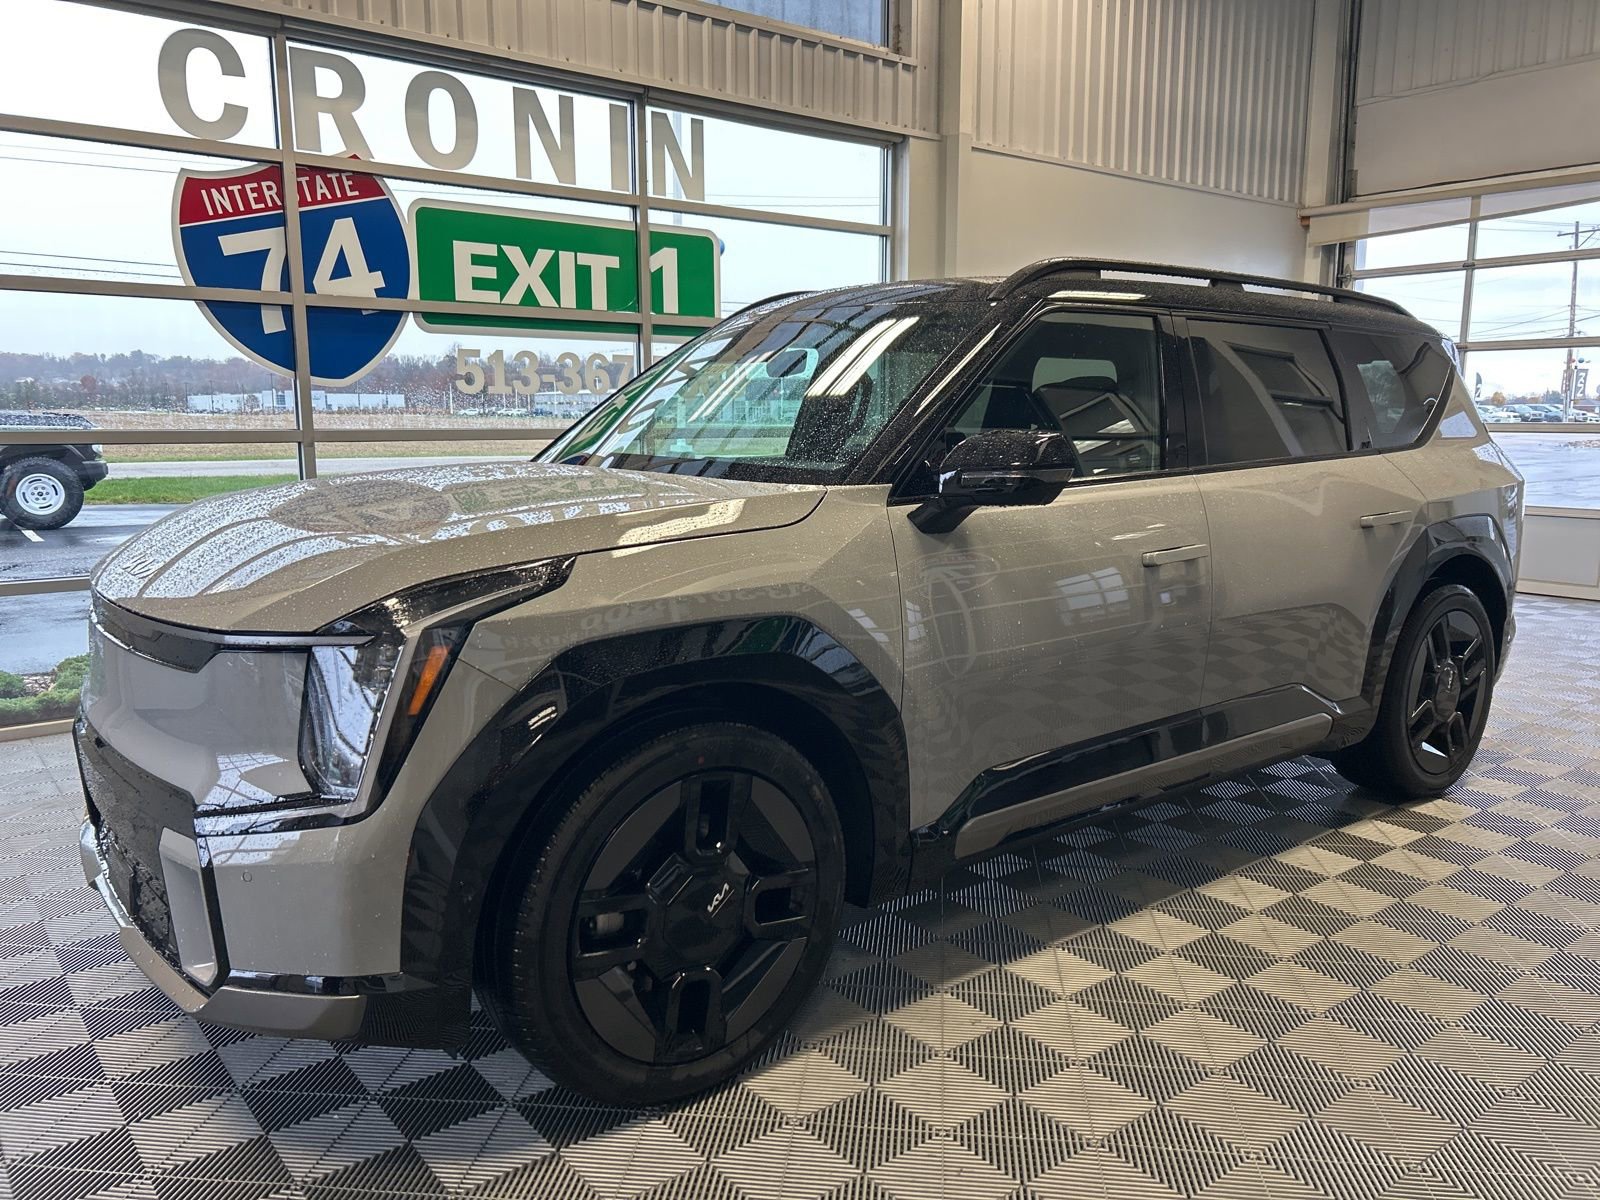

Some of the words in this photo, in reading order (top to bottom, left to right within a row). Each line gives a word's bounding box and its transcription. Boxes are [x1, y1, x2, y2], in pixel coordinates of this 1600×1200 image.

[158, 28, 705, 202] CRONIN
[201, 172, 360, 215] INTERTATE
[217, 216, 386, 334] 74
[452, 239, 620, 312] EXIT
[649, 246, 679, 315] 1
